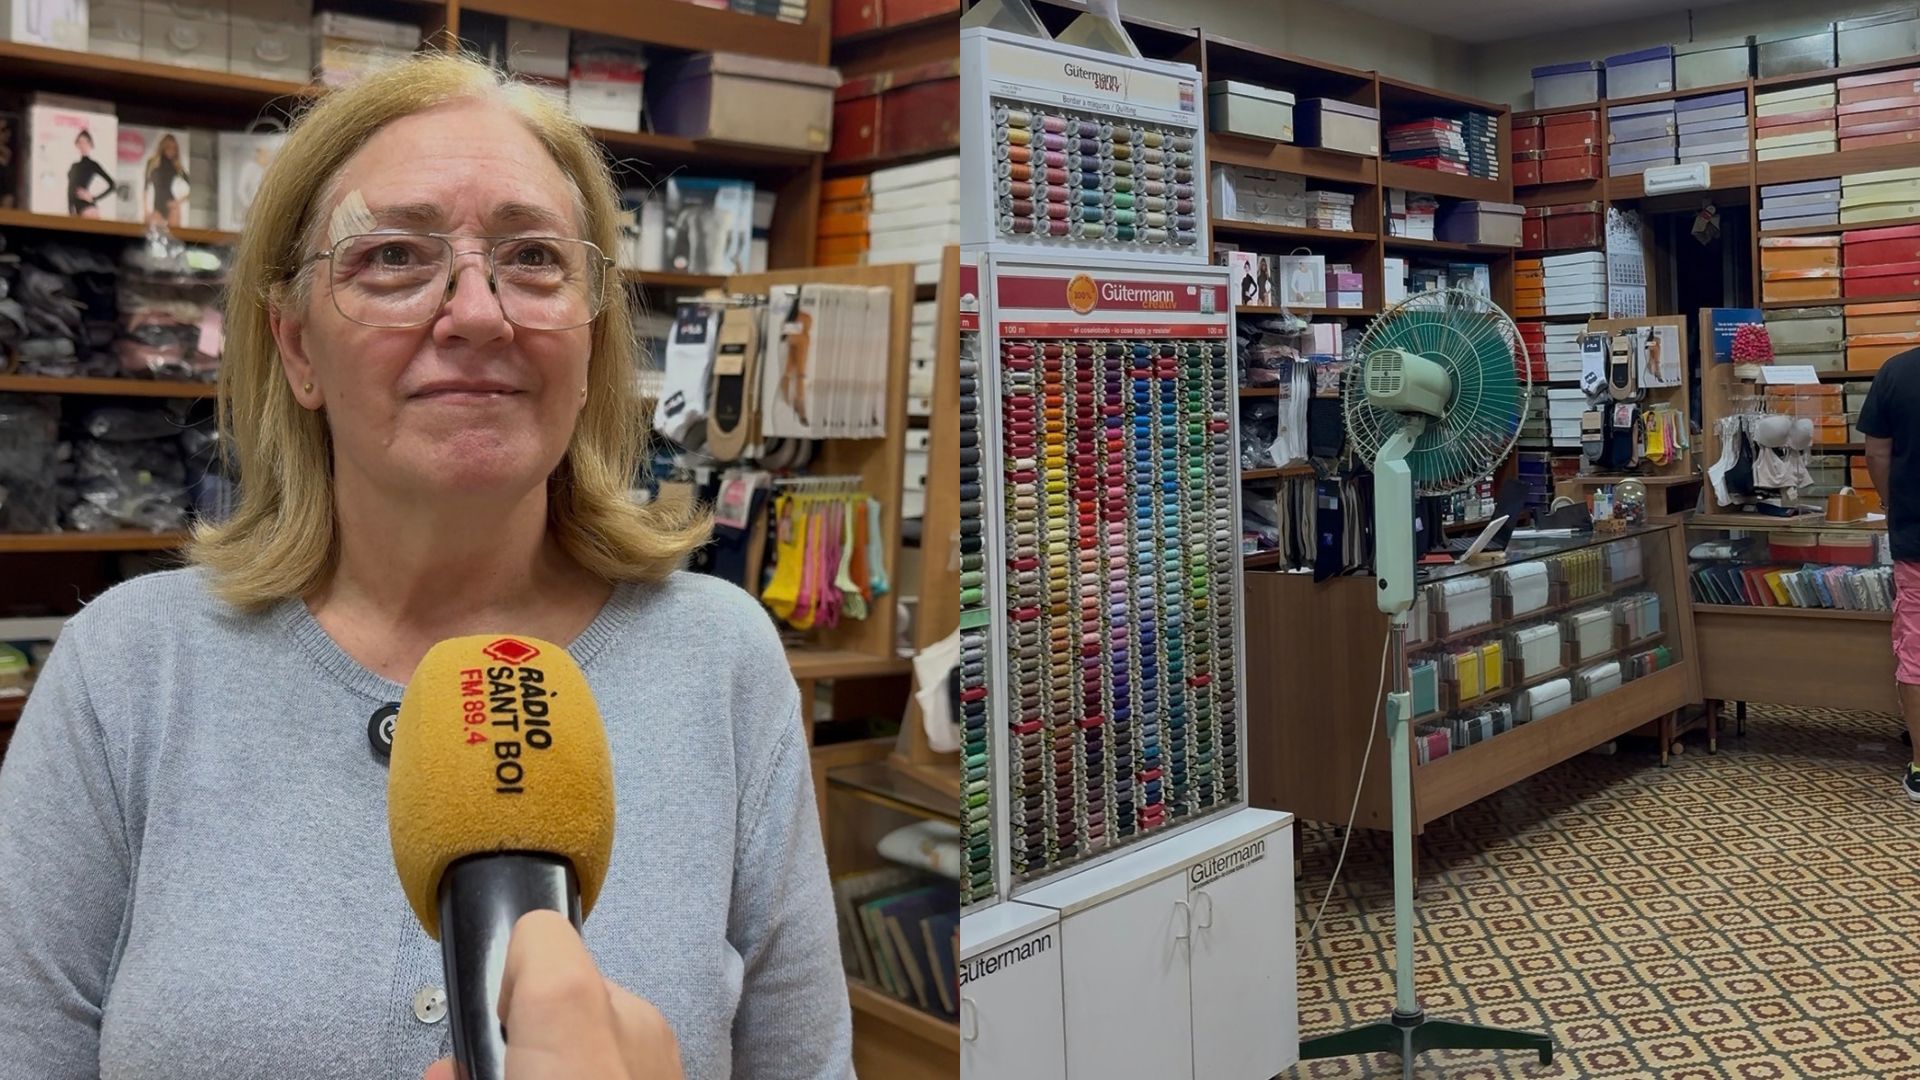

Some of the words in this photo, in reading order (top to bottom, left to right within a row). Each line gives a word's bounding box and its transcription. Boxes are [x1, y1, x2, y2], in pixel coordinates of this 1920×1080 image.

[1063, 63, 1119, 85] Gütermann
[1094, 80, 1120, 92] SULKY
[1101, 283, 1174, 303] Gütermann
[1142, 299, 1177, 310] creativ
[1004, 325, 1017, 334] 100
[1018, 326, 1025, 334] m
[459, 668, 484, 697] FM
[486, 666, 520, 732] SANT
[517, 667, 557, 750] RÀDIO
[462, 700, 488, 746] 89.4
[494, 741, 524, 795] BOI
[1190, 839, 1265, 884] Gütermann
